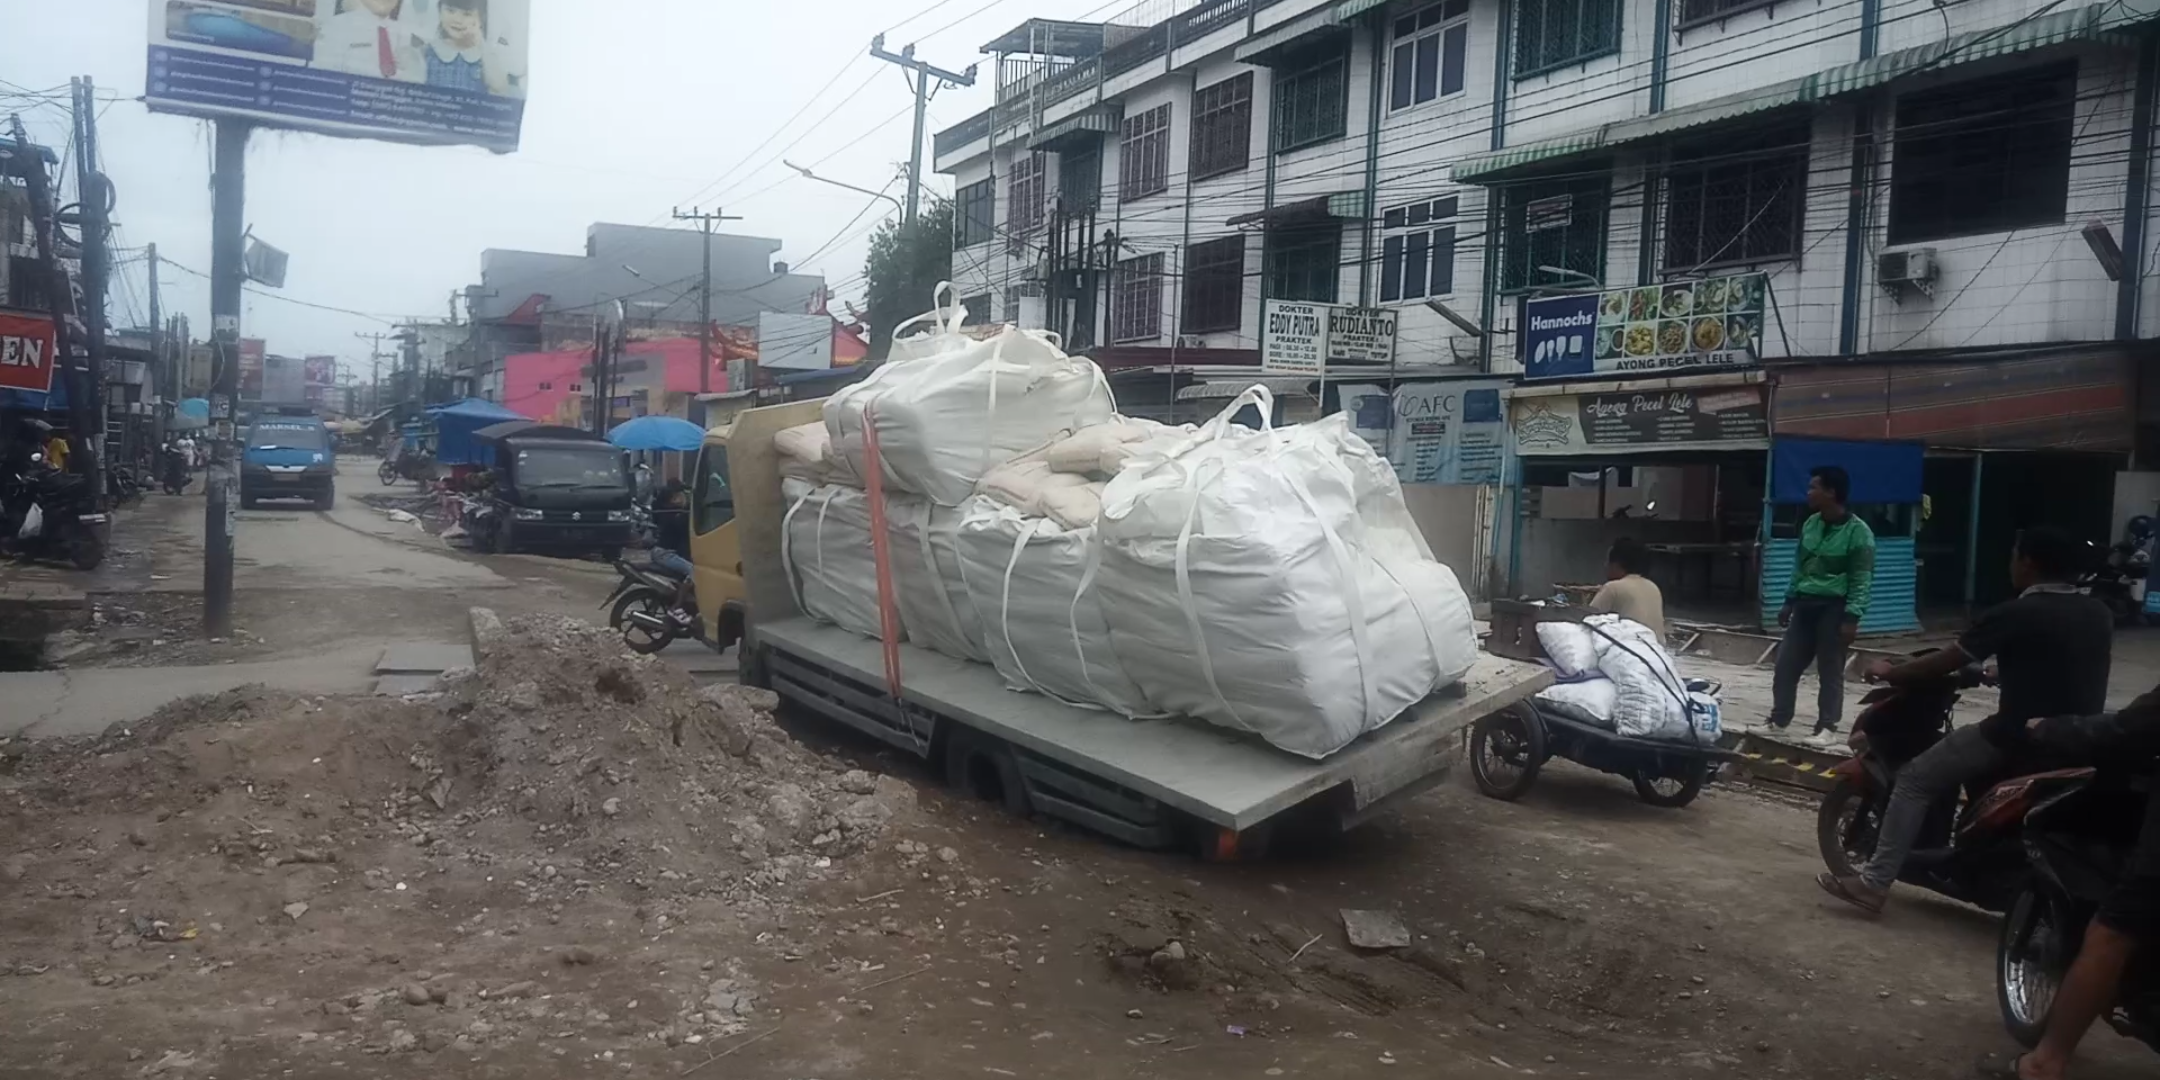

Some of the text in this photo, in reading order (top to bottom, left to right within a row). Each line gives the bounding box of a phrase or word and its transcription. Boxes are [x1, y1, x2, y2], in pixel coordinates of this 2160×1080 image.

[1279, 305, 1313, 315] DOKTER
[1345, 308, 1379, 317] DOKTER
[1269, 313, 1320, 337] EDDY PUTRA
[1330, 315, 1394, 337] RUDIANTO
[1531, 310, 1593, 331] Hannochs
[1276, 335, 1312, 345] PRAKTEK
[1616, 353, 1734, 370] AYONG PECEL LELE
[1418, 396, 1455, 413] AFC
[1632, 395, 1664, 412] Pecel
[1668, 392, 1693, 413] Lele
